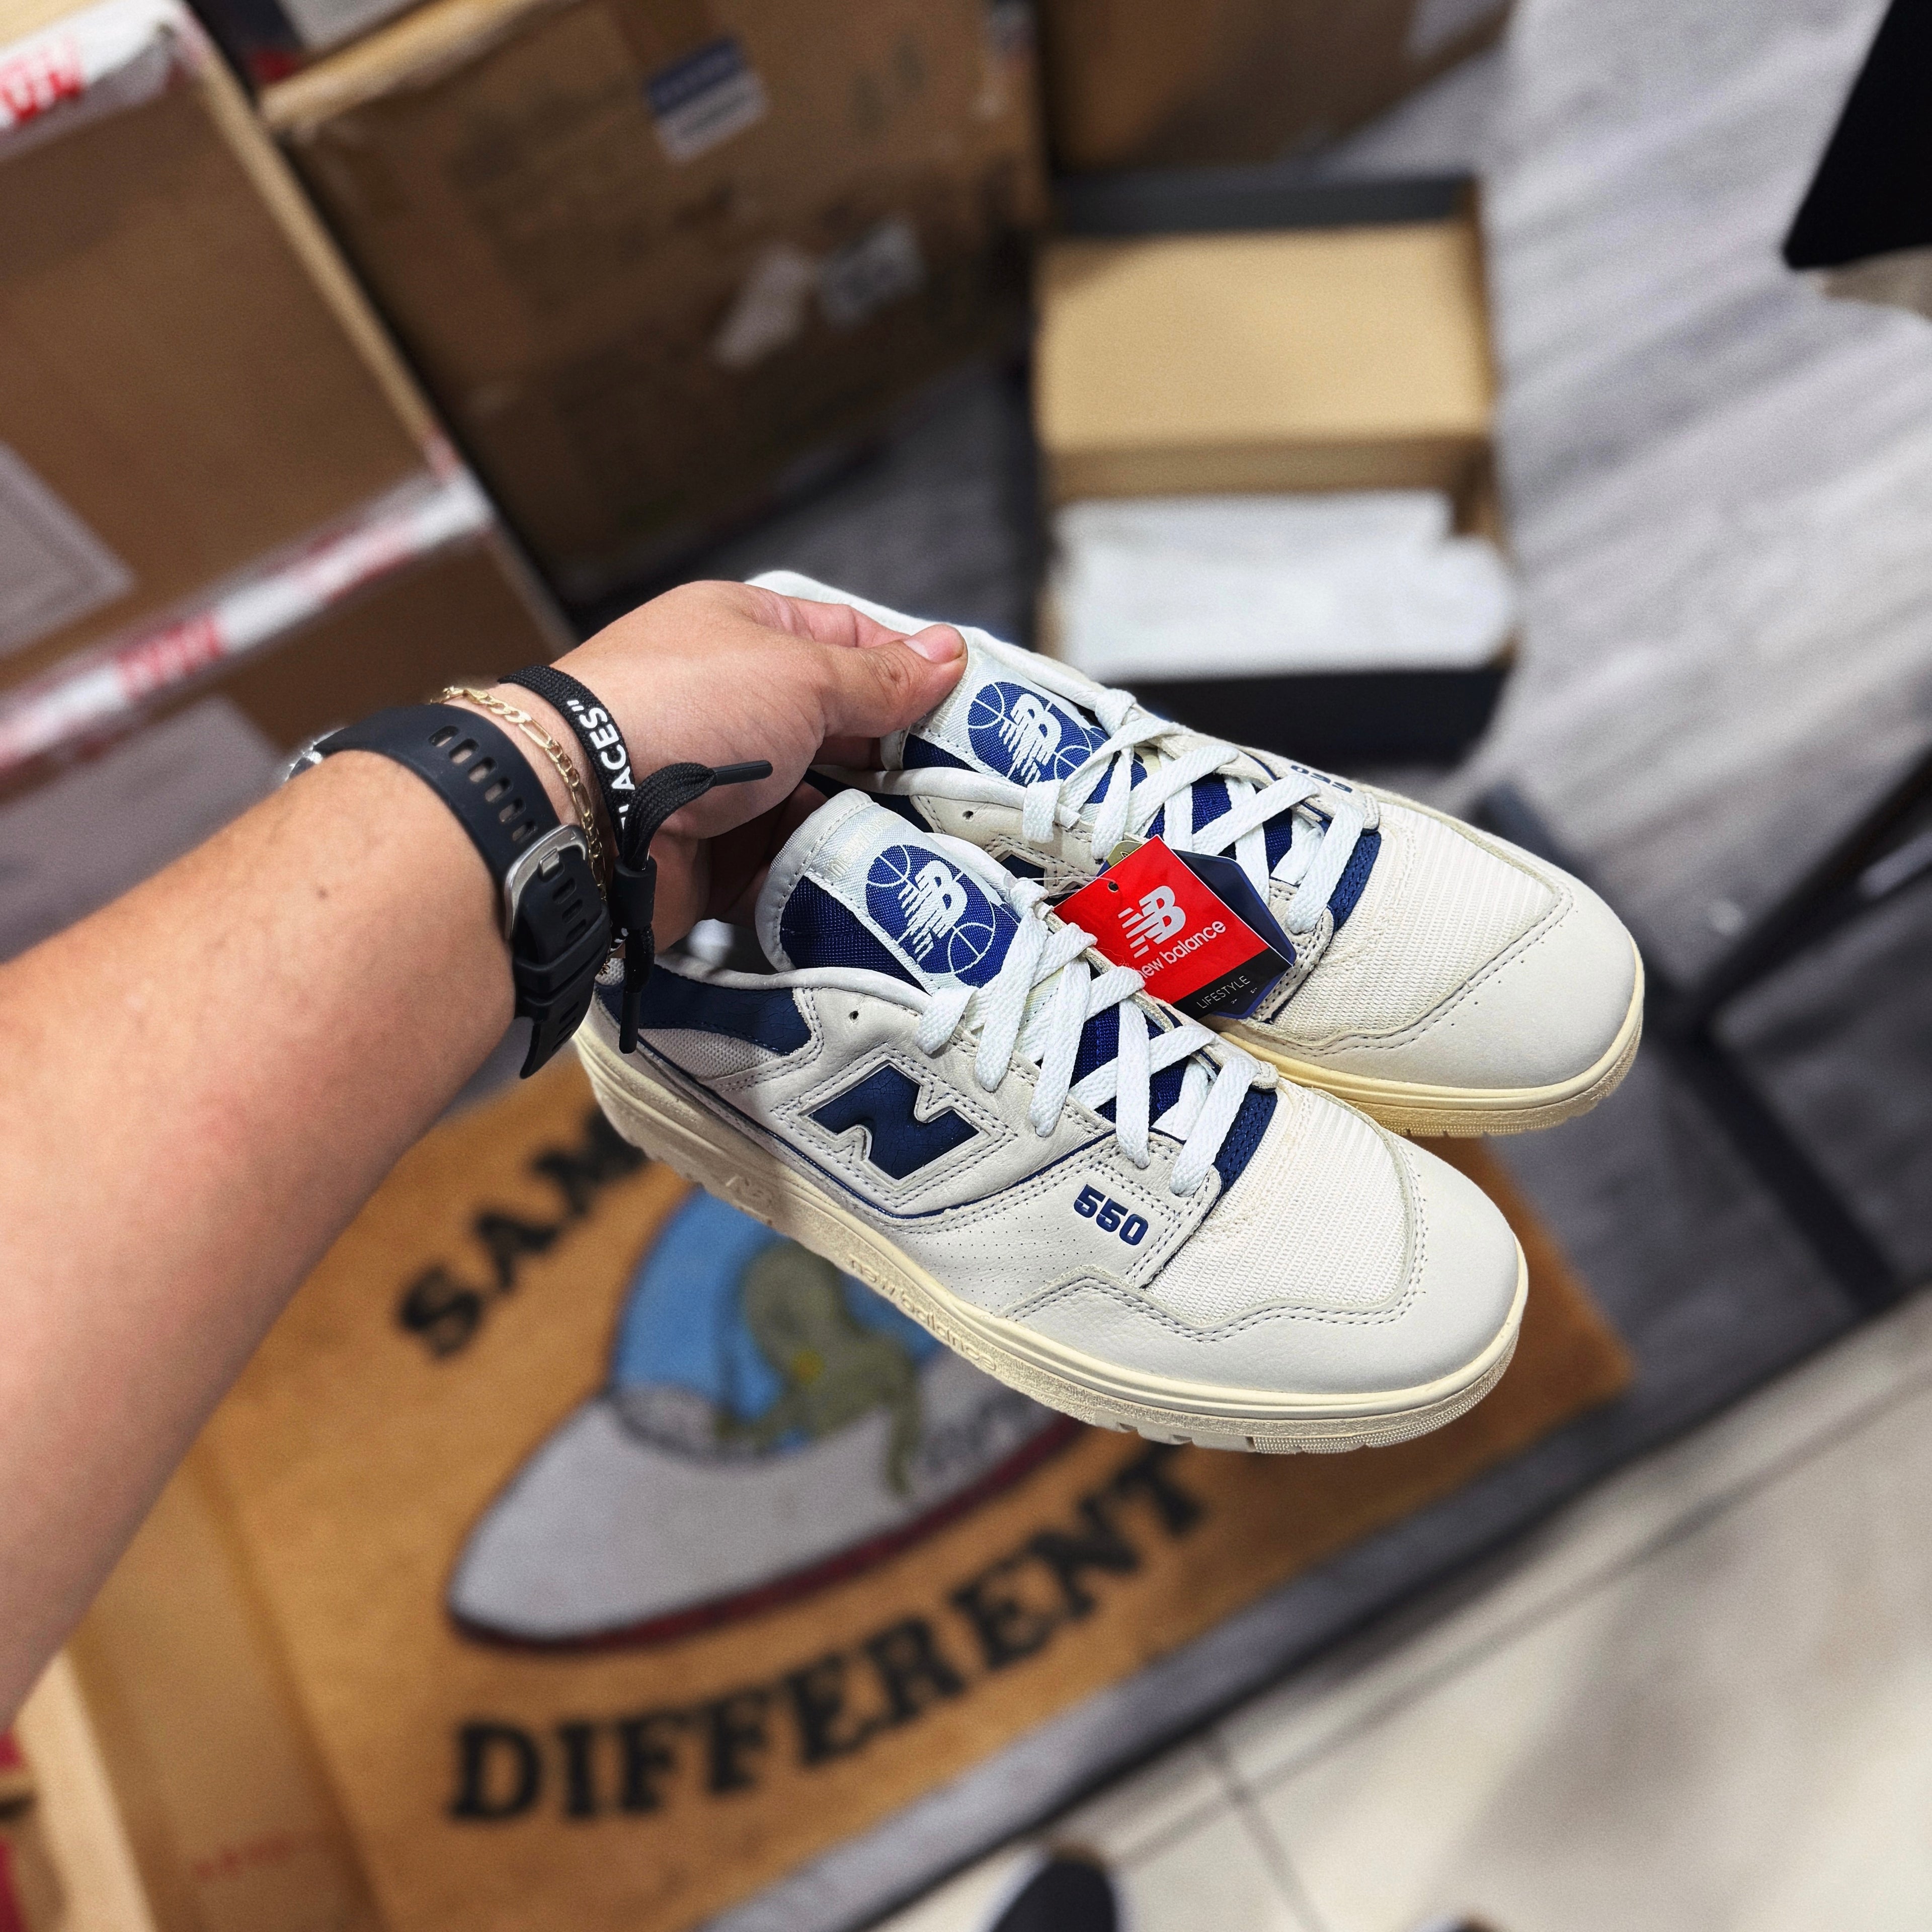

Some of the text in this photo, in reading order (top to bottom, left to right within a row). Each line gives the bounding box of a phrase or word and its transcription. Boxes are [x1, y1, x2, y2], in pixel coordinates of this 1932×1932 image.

[567, 700, 635, 830] ACES"
[1159, 921, 1226, 964] balance
[1196, 975, 1251, 1009] LIFESTYLE
[400, 1104, 649, 1359] SAM
[1073, 1184, 1149, 1246] 550
[453, 1443, 1202, 1820] DIFFERENT
